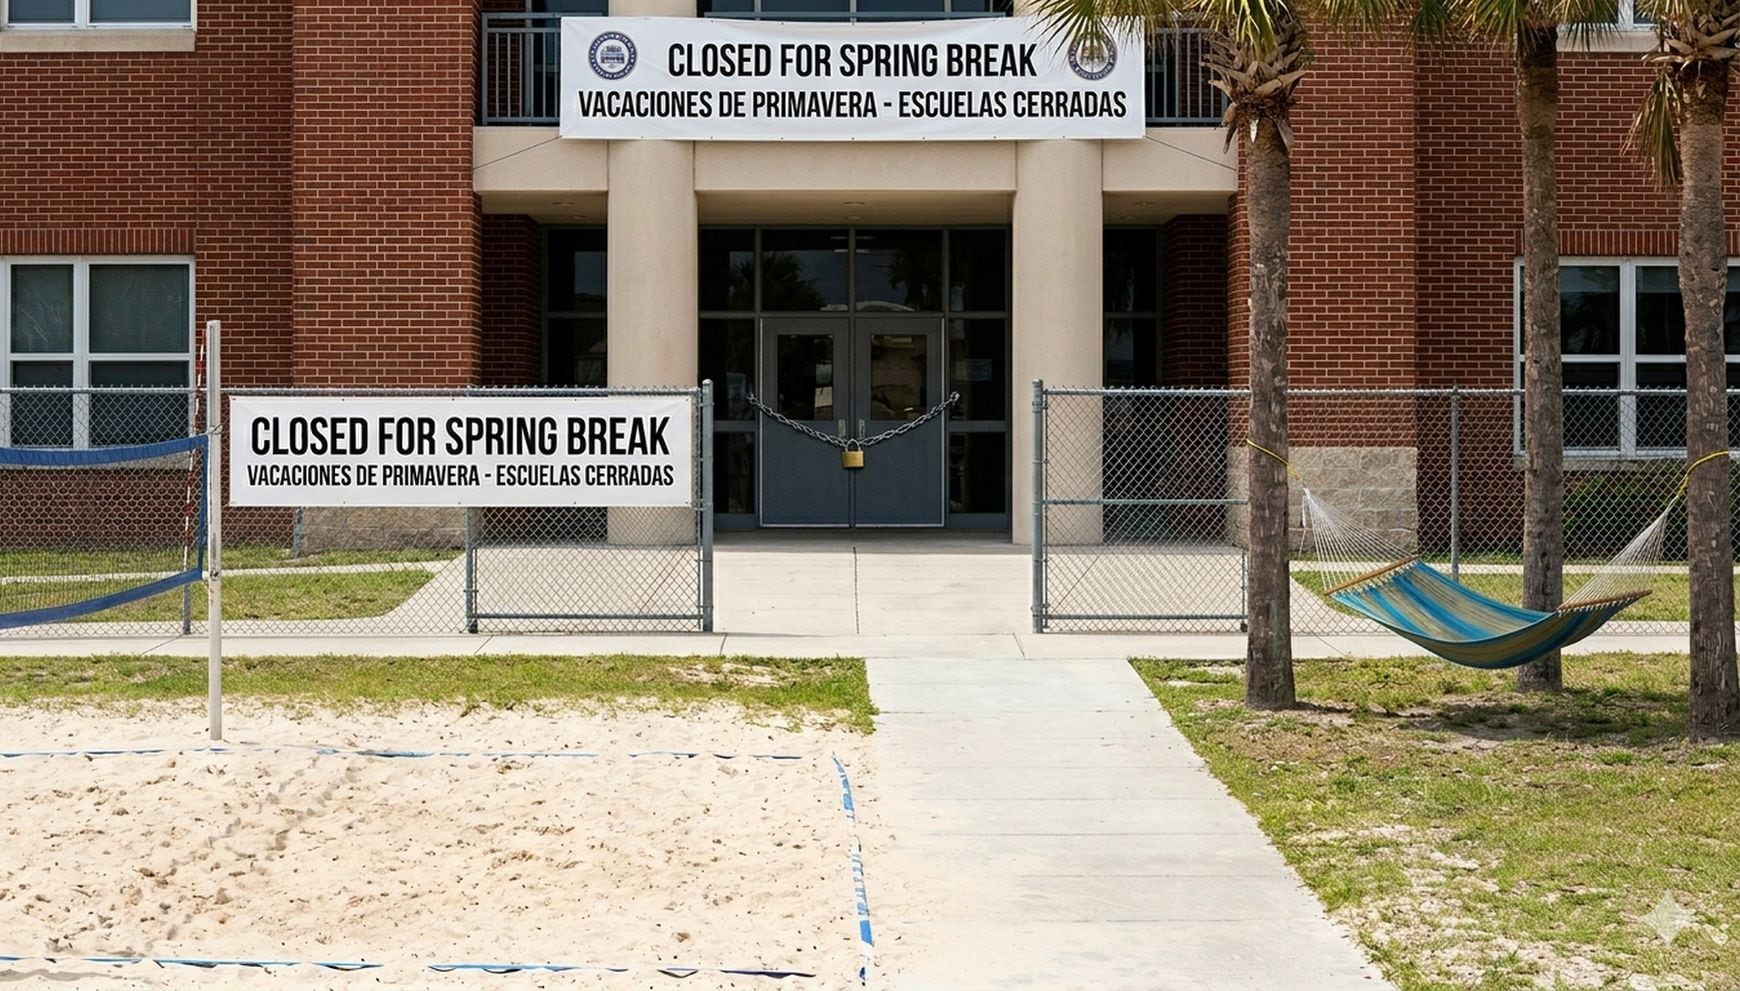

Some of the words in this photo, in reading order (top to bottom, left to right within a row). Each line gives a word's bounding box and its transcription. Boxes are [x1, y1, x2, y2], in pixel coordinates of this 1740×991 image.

[668, 43, 772, 77] CLOSED
[780, 43, 832, 78] FOR
[839, 43, 938, 77] SPRING
[946, 43, 1037, 77] BREAK
[578, 90, 713, 118] VACACIONES
[718, 91, 746, 118] DE
[752, 91, 878, 118] PRIMAVERA
[898, 90, 1007, 118] ESCUELAS
[1013, 90, 1127, 118] CERRADAS
[251, 416, 369, 456] CLOSED
[378, 416, 436, 456] FOR
[445, 416, 558, 456] SPRING
[567, 416, 670, 456] BREAK
[247, 464, 352, 486] VACACIONES
[356, 464, 378, 486] DE
[382, 464, 481, 486] PRIMAVERA
[496, 464, 581, 486] ESCUELAS
[585, 464, 674, 486] CERRADAS
